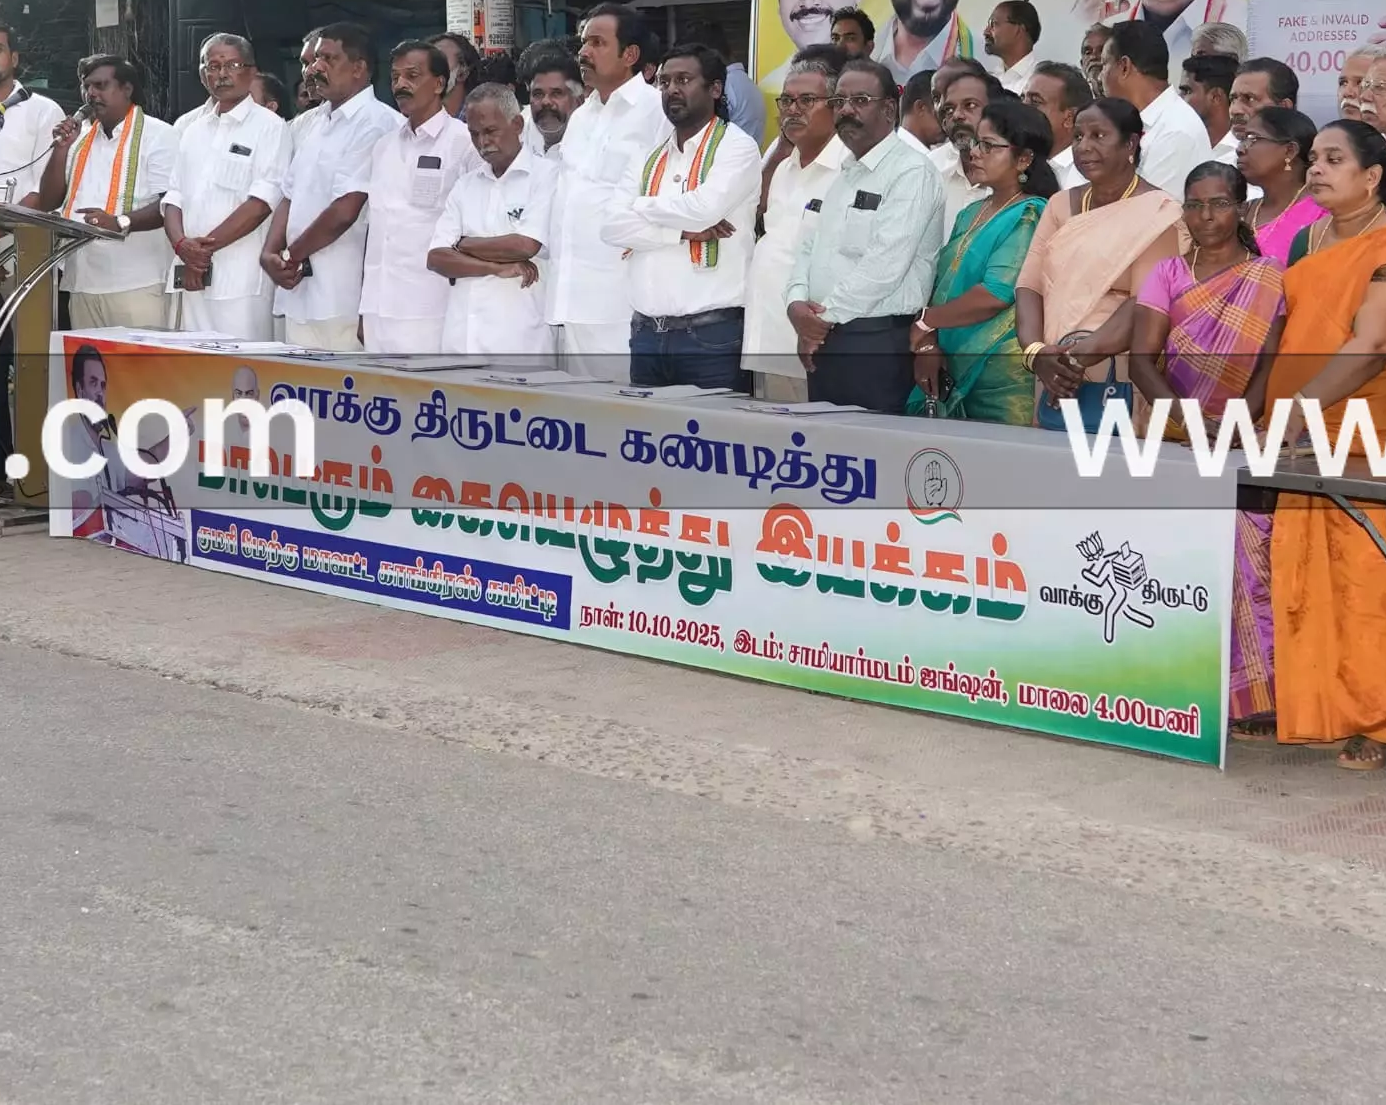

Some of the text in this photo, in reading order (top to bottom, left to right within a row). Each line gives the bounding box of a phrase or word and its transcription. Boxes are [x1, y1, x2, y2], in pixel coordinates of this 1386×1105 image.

[1278, 16, 1307, 28] FAKE
[1321, 14, 1370, 26] INVALID
[1290, 29, 1357, 42] ADDRESSES
[411, 390, 607, 458] திருட்டை
[620, 419, 877, 504] கண்டித்து
[196, 523, 558, 620] குமரி மேற்கு மாவட்ட காங்கிரஸ் கமிட்டி
[412, 475, 733, 606] கையெழுத்து
[756, 502, 1029, 622] இயக்கம்
[1040, 584, 1104, 615] வாக்கு
[1141, 578, 1209, 612] திருட்டு
[579, 602, 624, 629] நாள்:
[628, 609, 725, 653] 10.10.2025,
[734, 629, 783, 661] இடம்:
[788, 641, 915, 685] சாமியார்மடம்
[1019, 682, 1089, 716] மாலை
